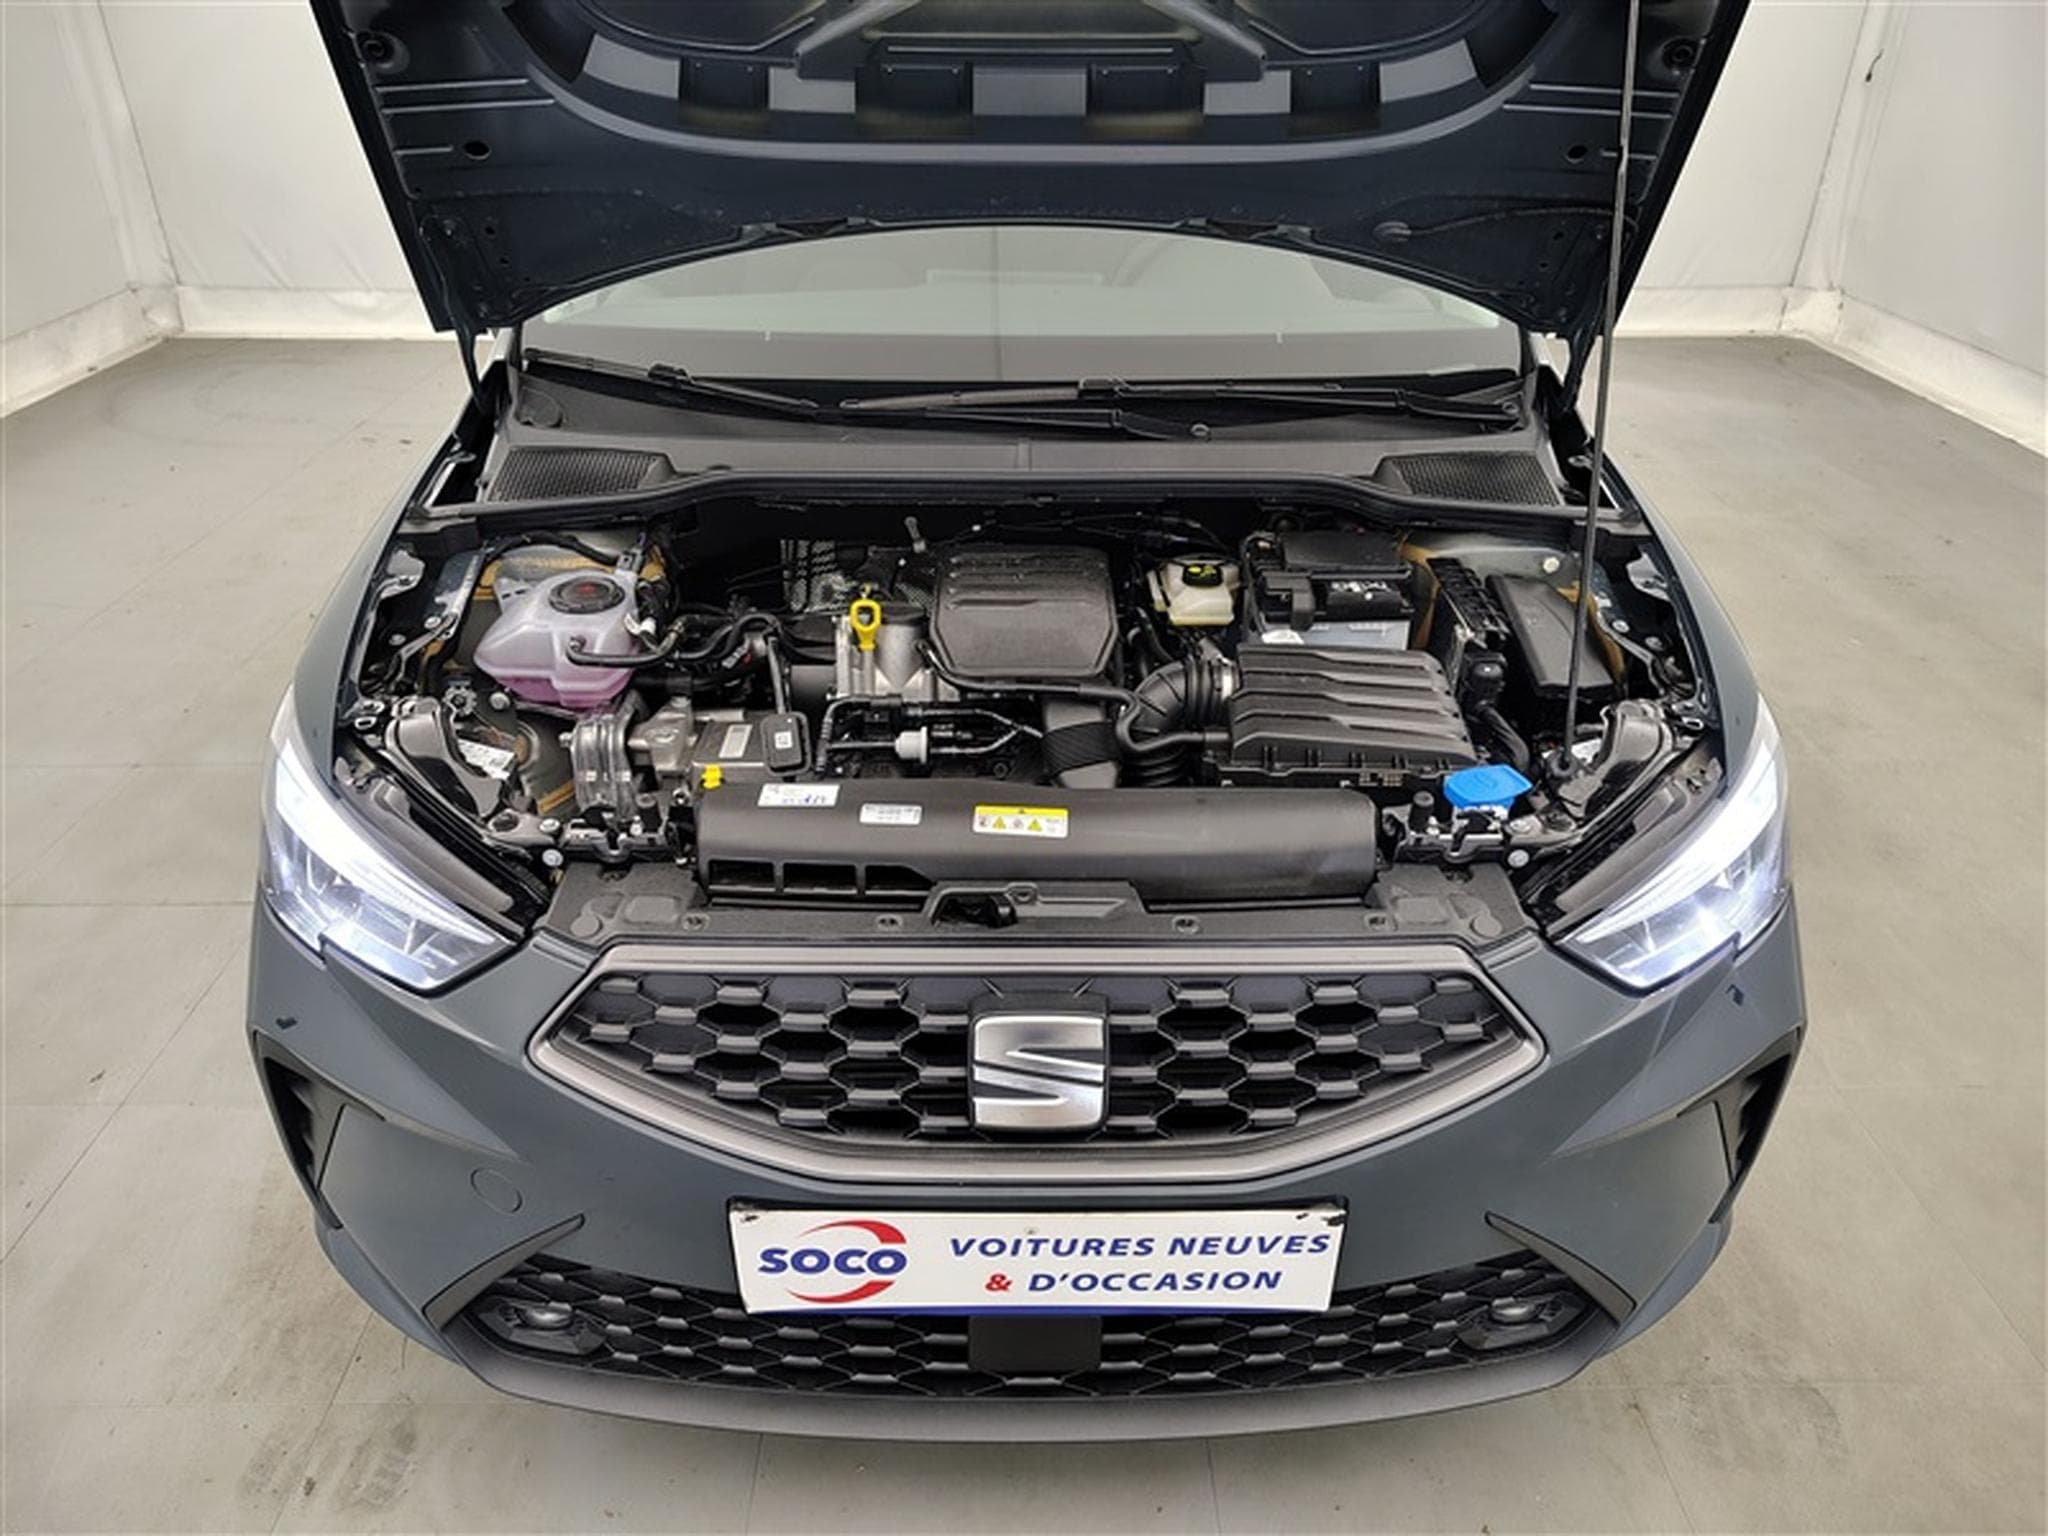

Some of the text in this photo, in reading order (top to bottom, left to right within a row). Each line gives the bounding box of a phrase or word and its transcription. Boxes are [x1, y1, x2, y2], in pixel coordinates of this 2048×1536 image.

[951, 1235, 1330, 1256] VOITURES NEUVES
[759, 1248, 907, 1275] SOCO
[985, 1271, 1282, 1292] & D'OCCASION
